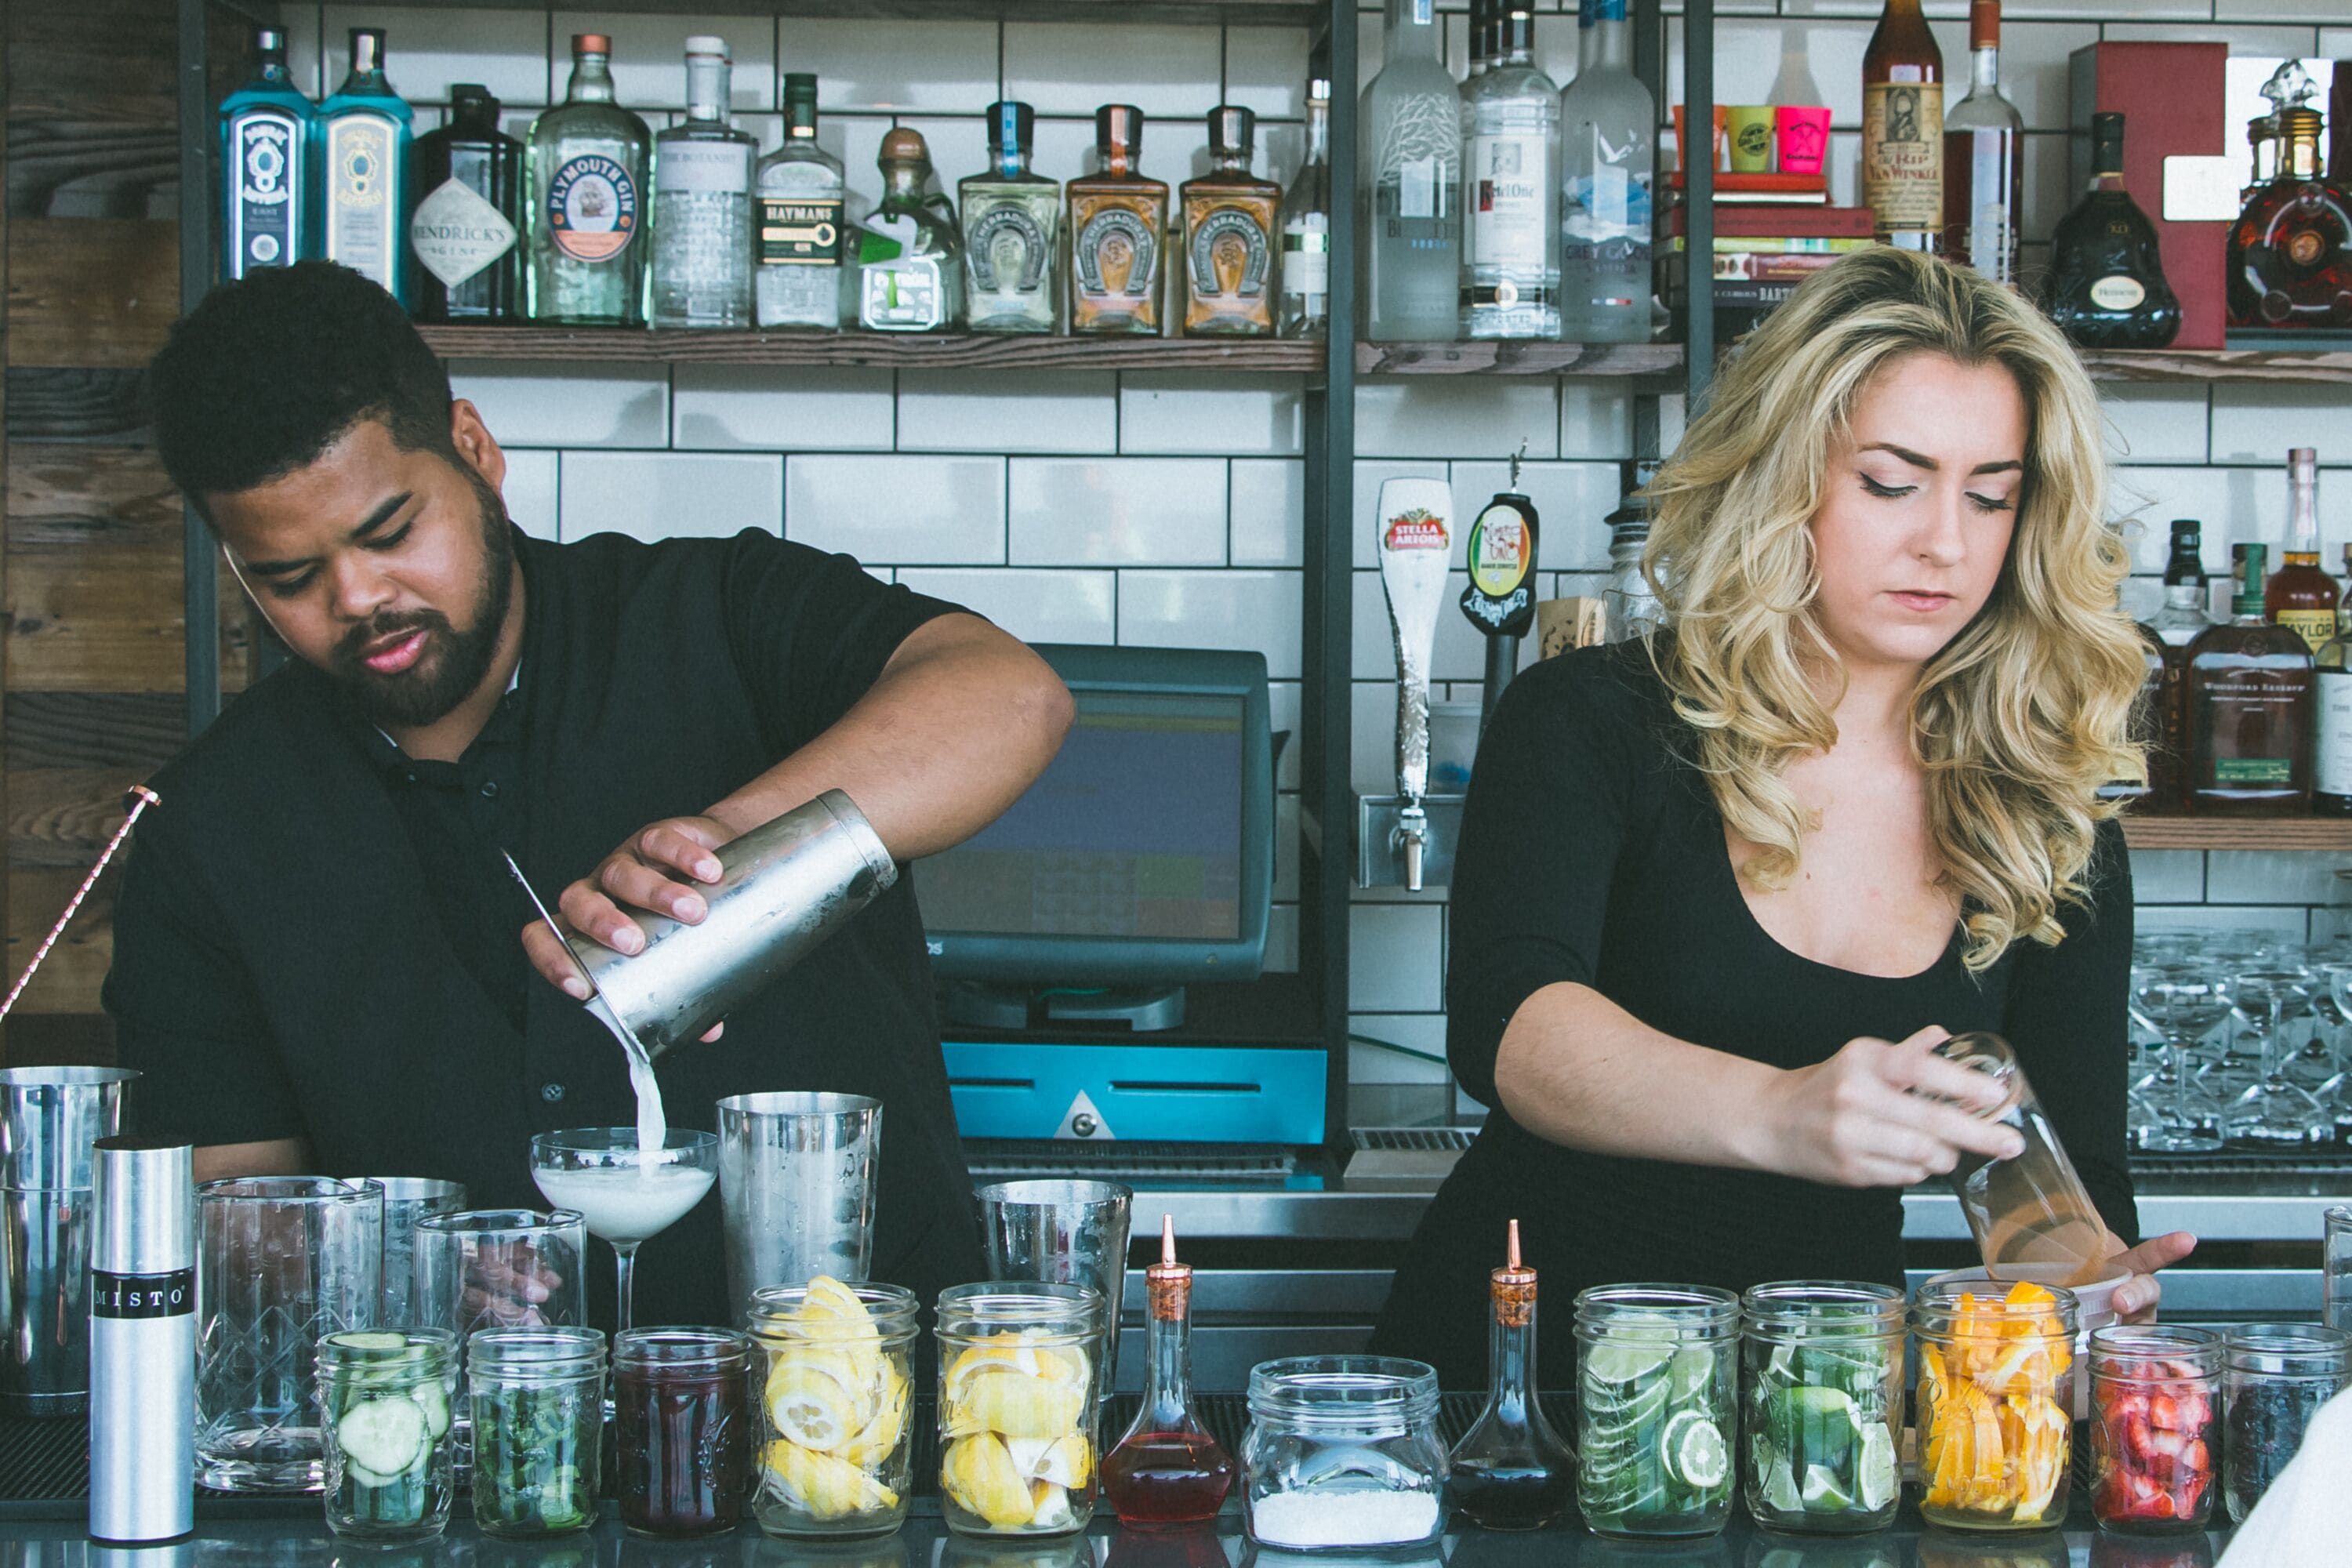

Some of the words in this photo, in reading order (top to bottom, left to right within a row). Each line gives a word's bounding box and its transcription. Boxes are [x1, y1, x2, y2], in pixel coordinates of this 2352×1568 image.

[1890, 164, 1937, 180] WINKLE
[550, 158, 622, 209] PLYMOUTH
[616, 180, 634, 212] GIN
[1202, 215, 1259, 241] HERRADURA
[1395, 524, 1438, 535] STELLA
[1395, 535, 1439, 545] ARTOIS
[2278, 623, 2333, 637] AYLOR
[2203, 681, 2259, 691] WOODFORD
[2262, 683, 2307, 692] RESERVE
[94, 1288, 183, 1308] MISTO
